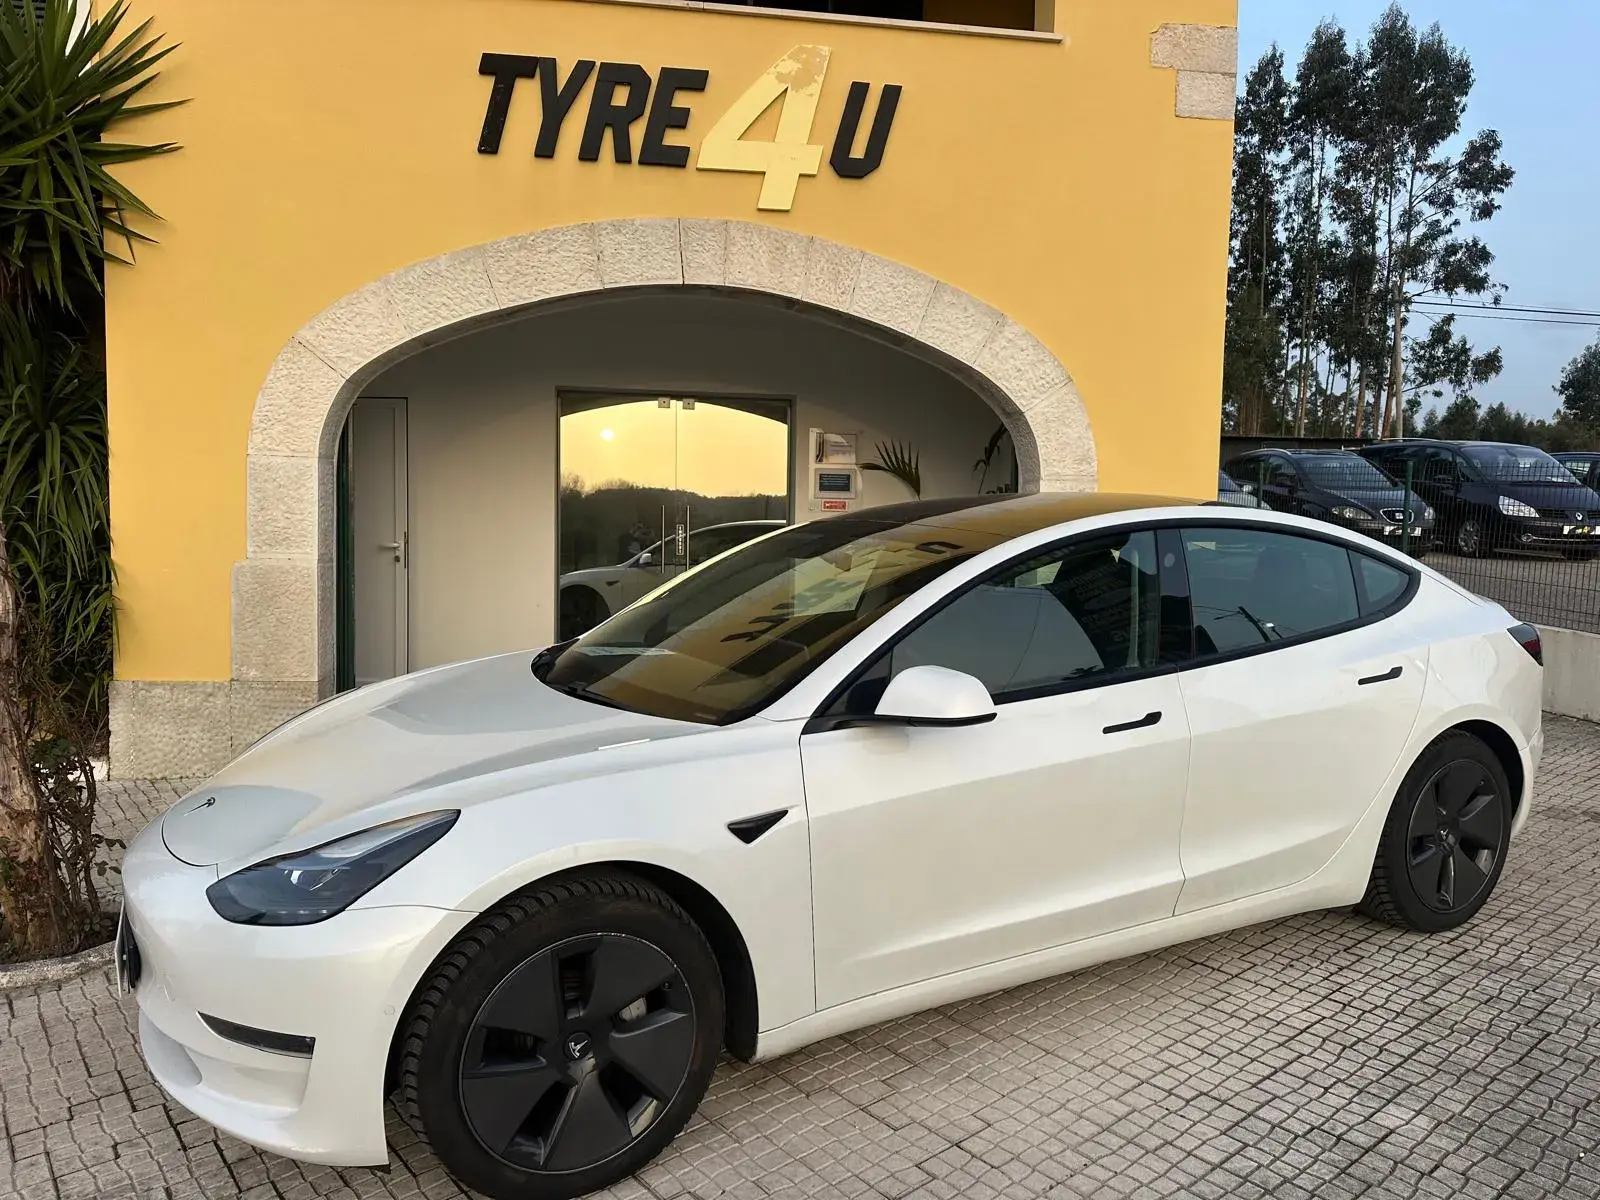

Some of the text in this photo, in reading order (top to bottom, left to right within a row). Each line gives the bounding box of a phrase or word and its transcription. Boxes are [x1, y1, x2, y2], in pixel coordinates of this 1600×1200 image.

[478, 44, 903, 211] TYRE 4 U
